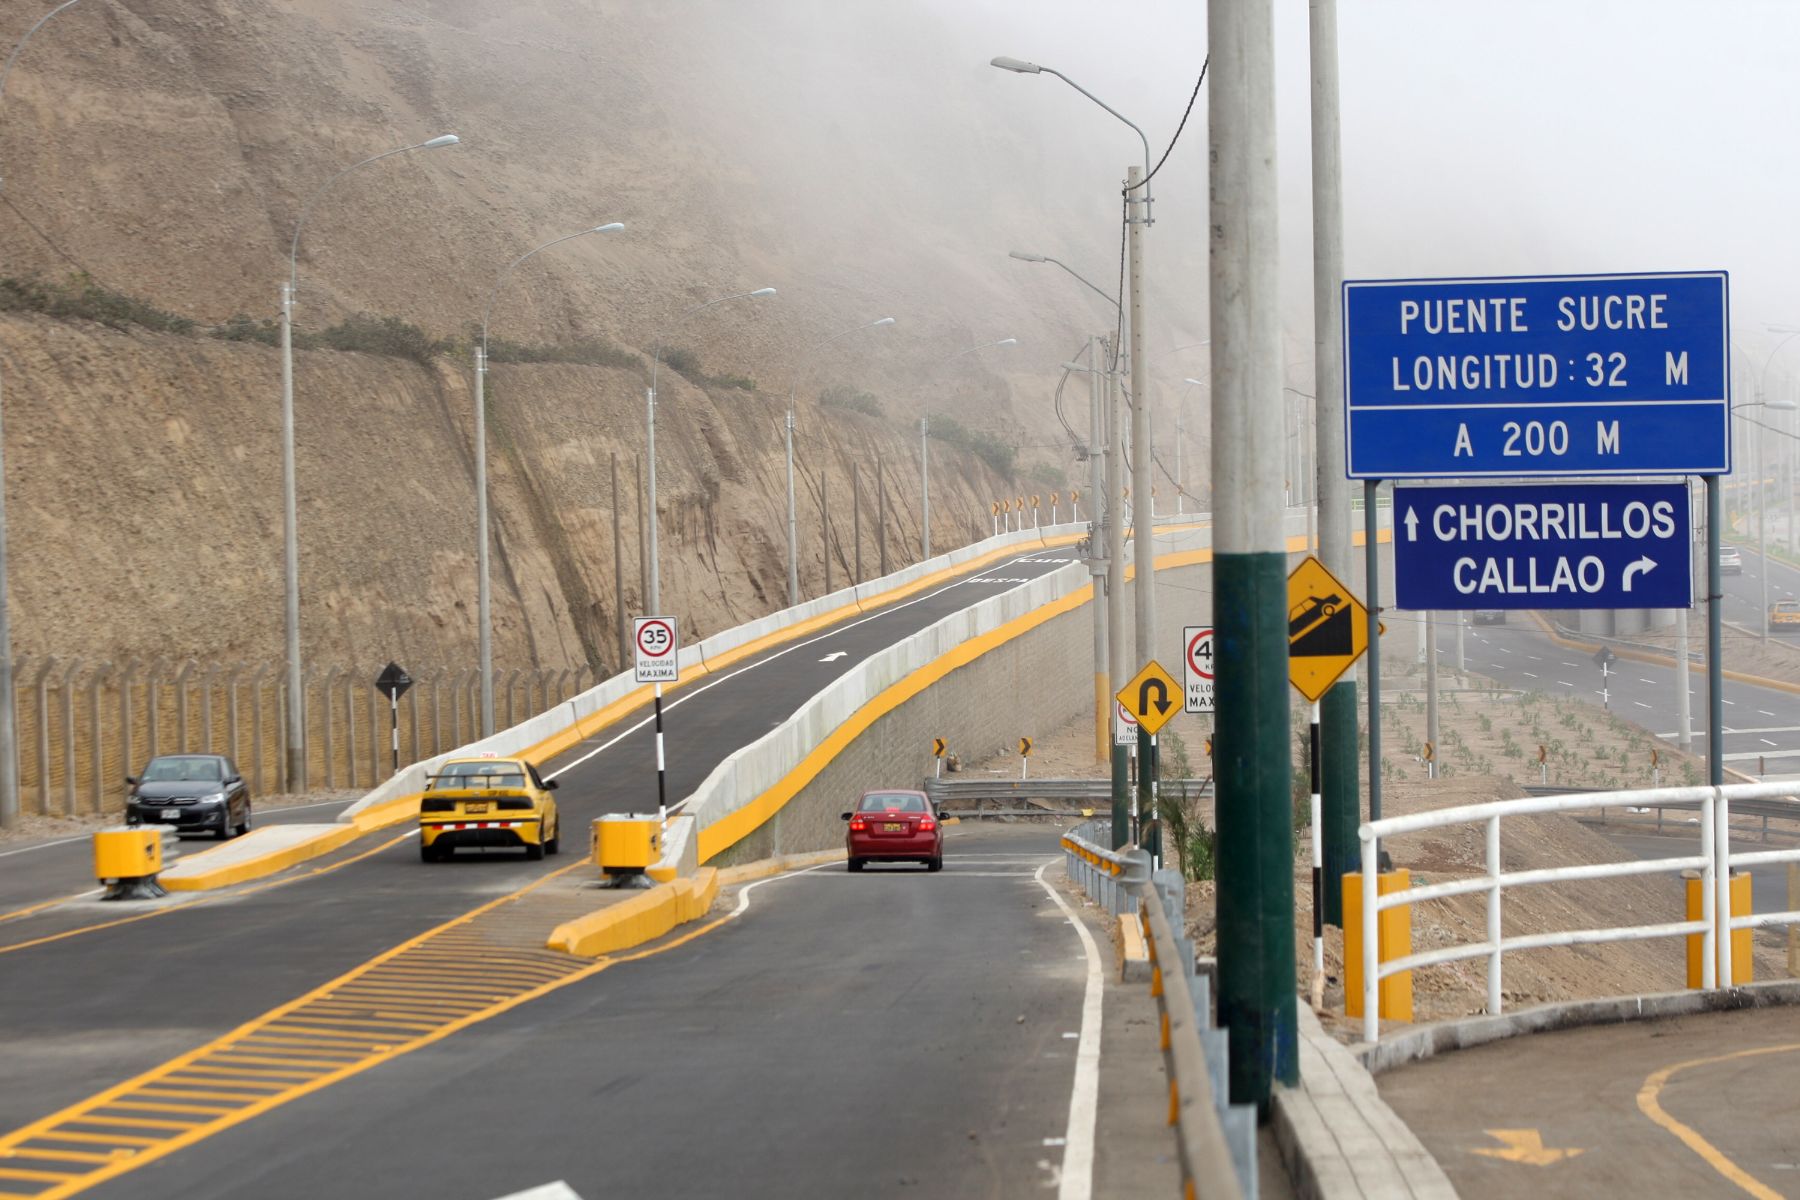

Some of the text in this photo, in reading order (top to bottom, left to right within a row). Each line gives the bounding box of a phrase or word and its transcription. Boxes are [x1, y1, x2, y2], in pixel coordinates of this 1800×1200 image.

[1400, 294, 1669, 335] PUENTE SUCRE
[1664, 351, 1689, 386] M
[1453, 420, 1621, 458] A 200 M
[1432, 501, 1676, 542] CHORRILLOS
[1452, 554, 1606, 595] CALLAO
[644, 629, 667, 644] 35
[1195, 641, 1213, 660] 4
[639, 660, 674, 668] VELOCIDAD
[639, 669, 674, 678] MAXIMA
[1190, 684, 1216, 693] VELOC
[1190, 697, 1216, 708] MAX
